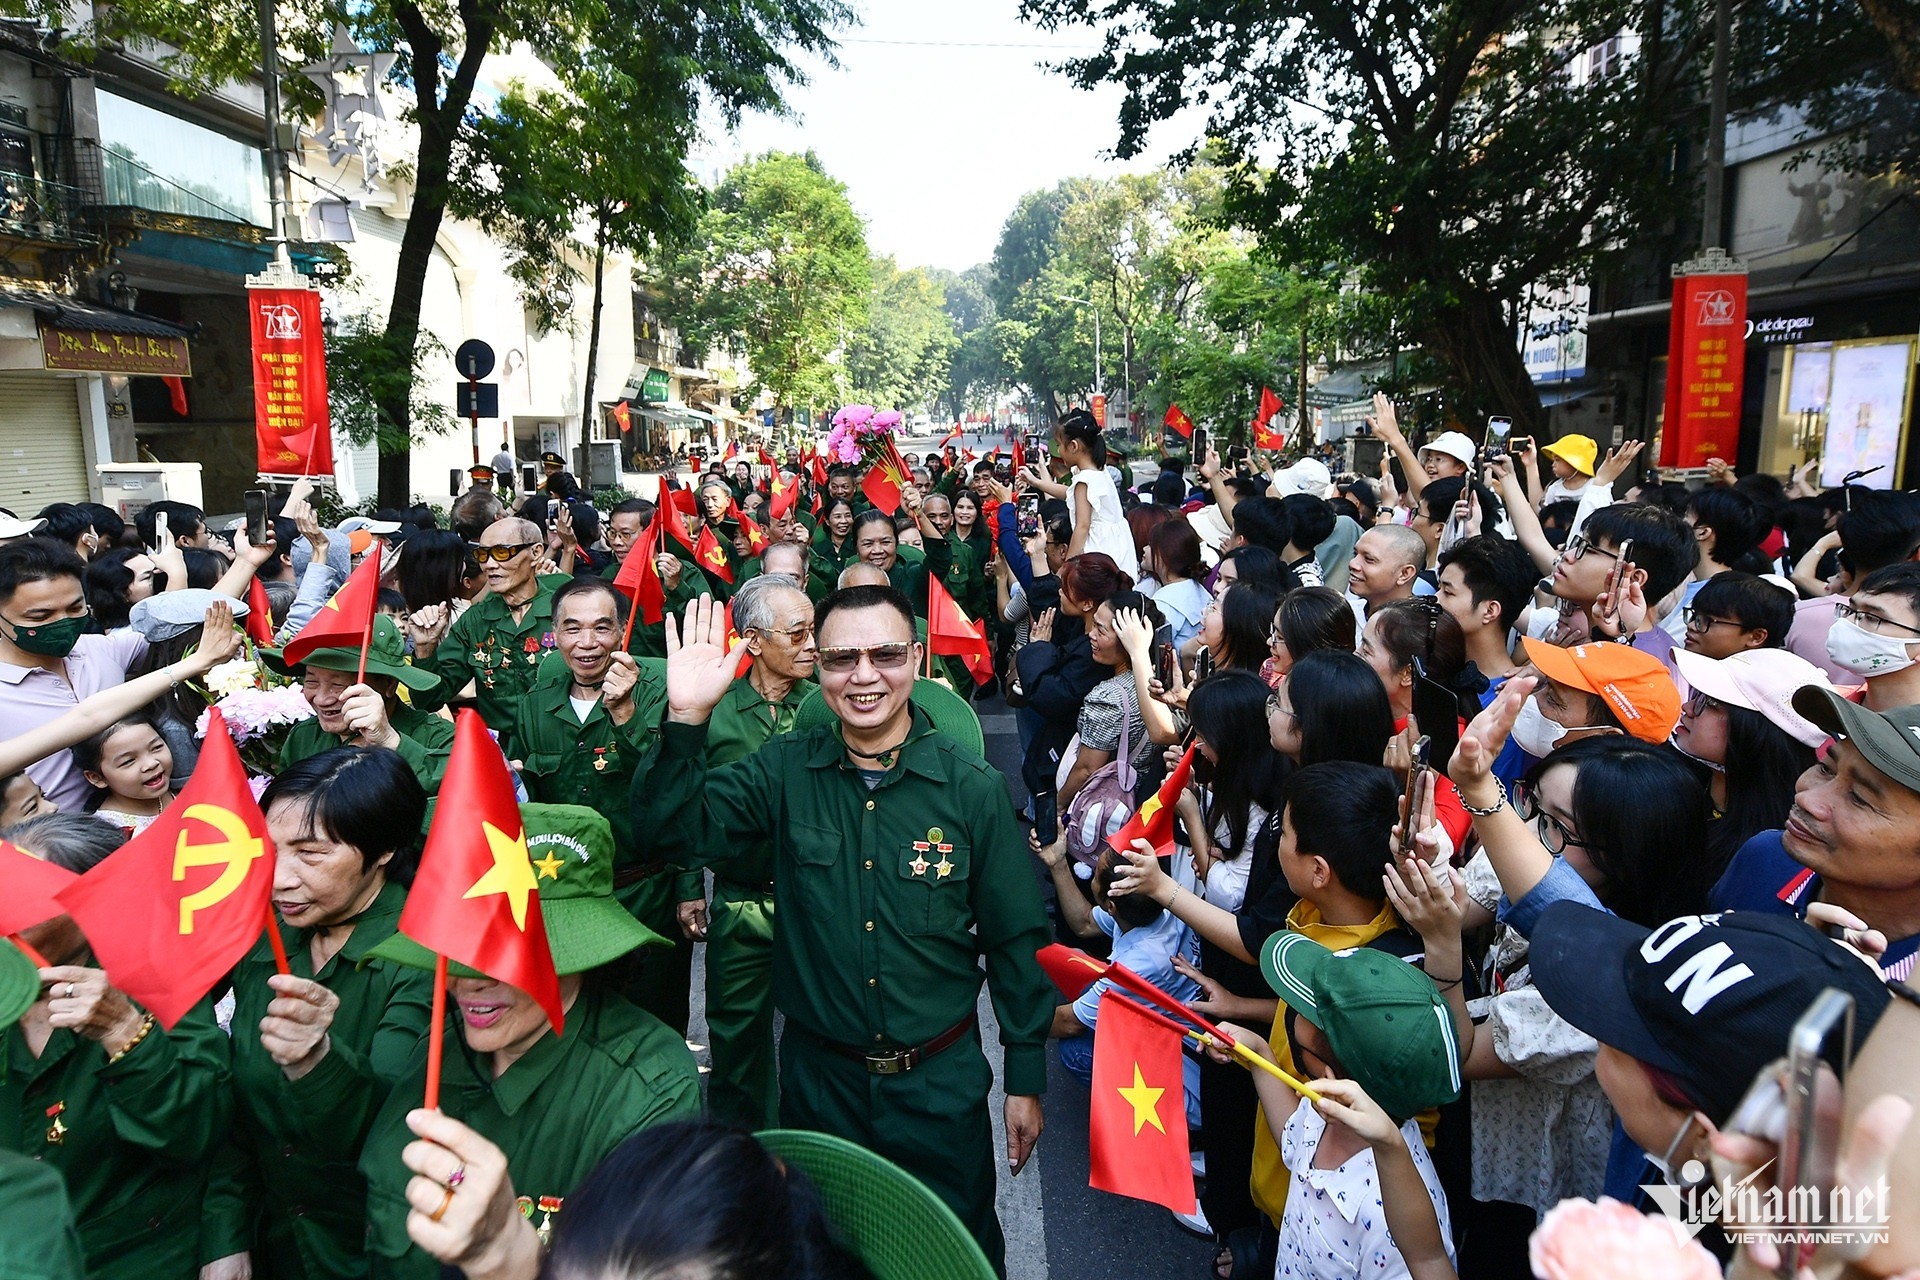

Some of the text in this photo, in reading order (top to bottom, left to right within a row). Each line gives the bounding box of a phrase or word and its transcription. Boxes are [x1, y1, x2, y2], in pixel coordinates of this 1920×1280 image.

[261, 352, 280, 363] PHÁT
[271, 364, 297, 376] THỦ ĐÔ
[272, 378, 298, 390] HÀ NỘI
[267, 390, 282, 402] VĂN
[266, 403, 304, 415] VĂN MINH,
[268, 416, 287, 429] HIỆN
